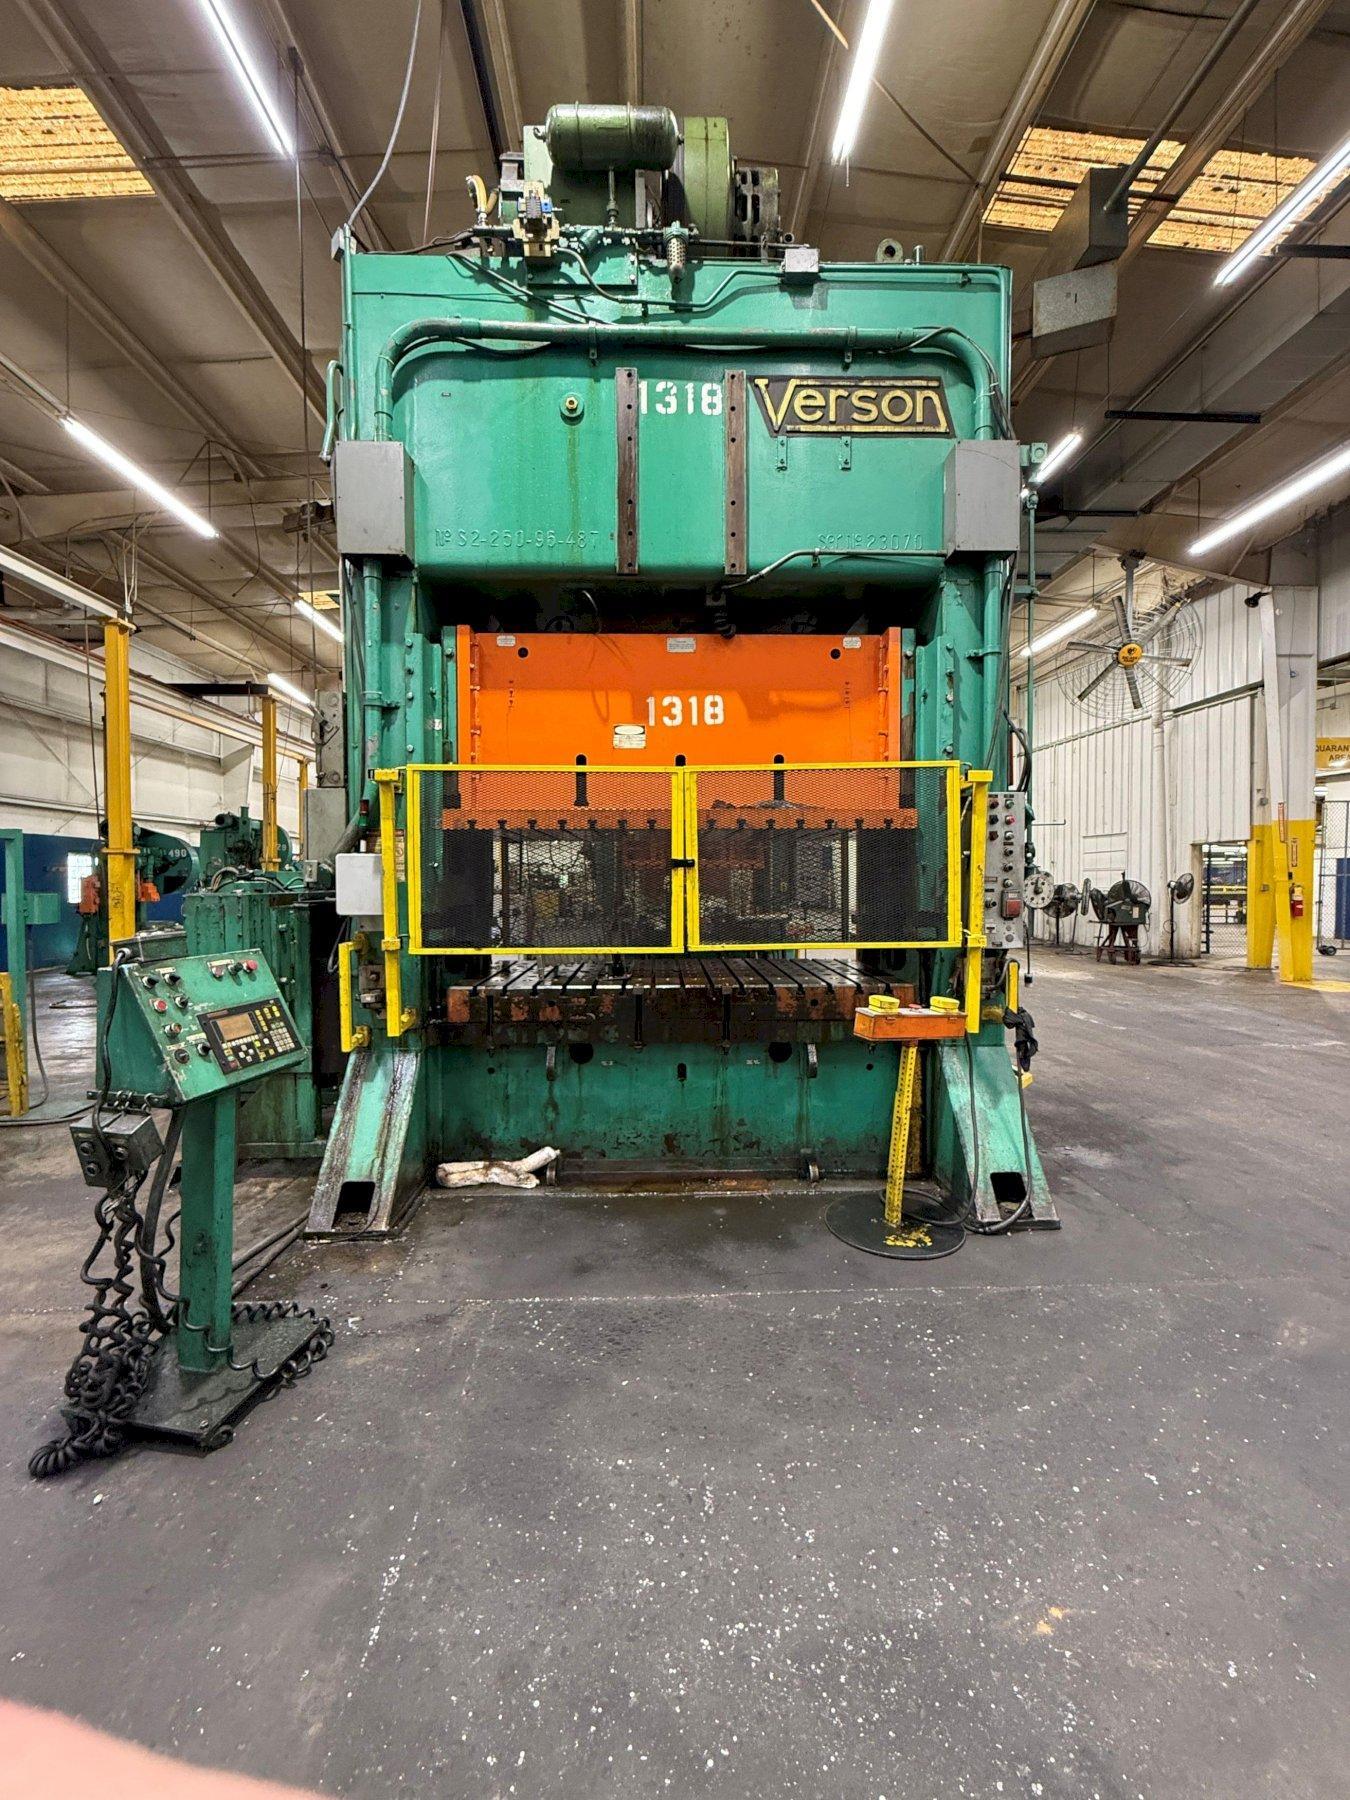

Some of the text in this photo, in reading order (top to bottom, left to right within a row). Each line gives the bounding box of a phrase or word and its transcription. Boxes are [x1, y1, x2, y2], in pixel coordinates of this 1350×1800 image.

[638, 380, 723, 416] 1318
[754, 378, 950, 432] Verson
[646, 694, 724, 727] 1318
[168, 848, 187, 858] 490
